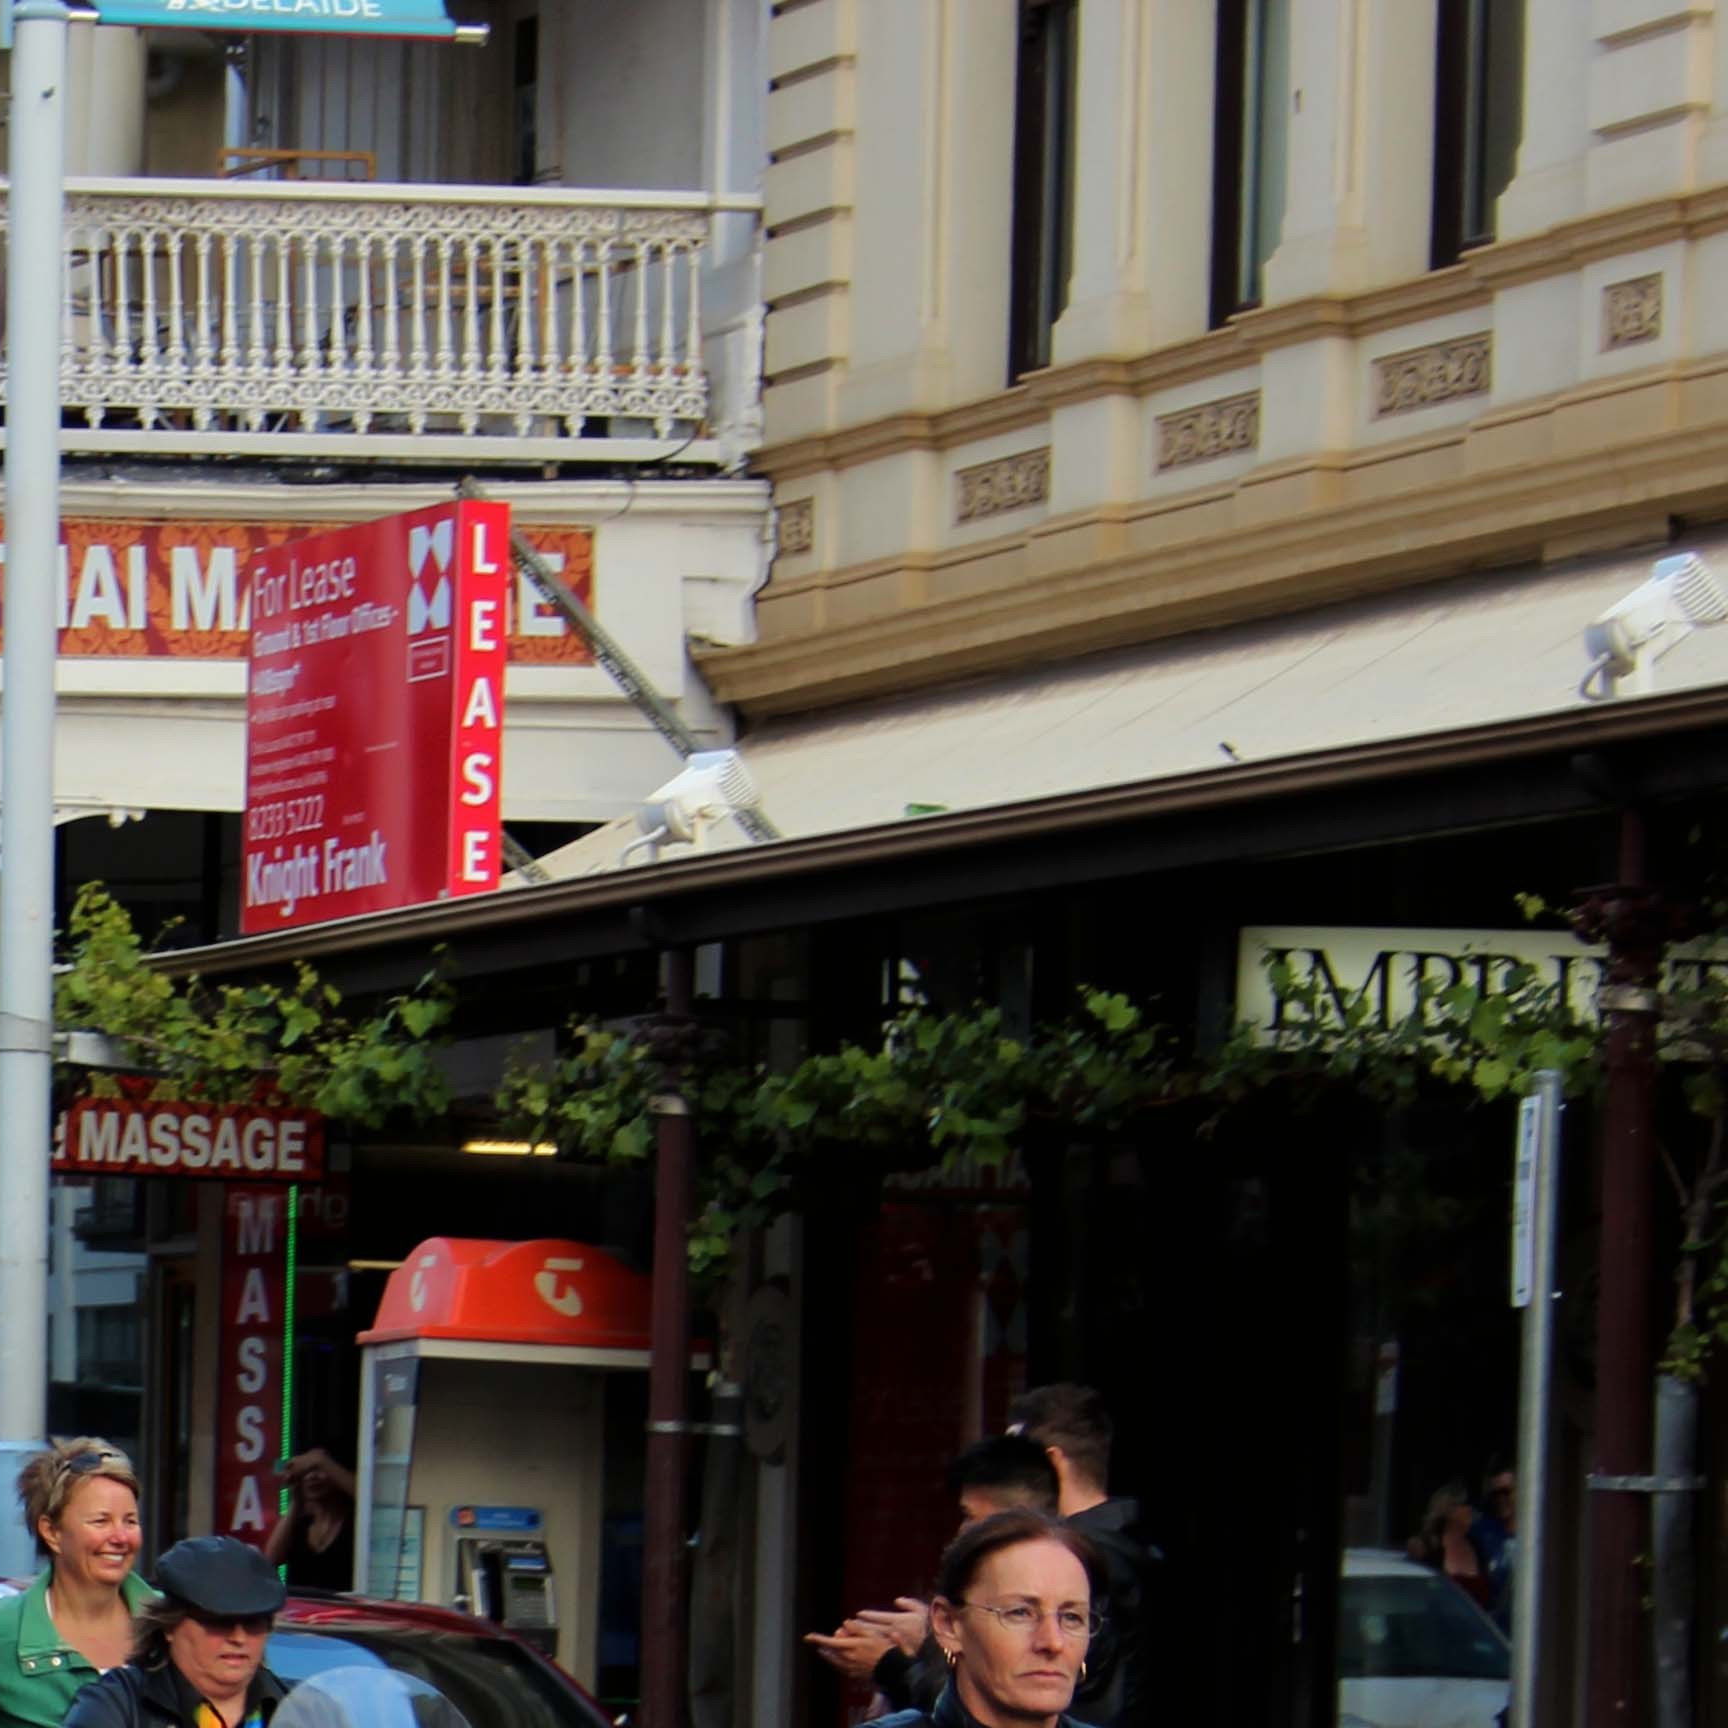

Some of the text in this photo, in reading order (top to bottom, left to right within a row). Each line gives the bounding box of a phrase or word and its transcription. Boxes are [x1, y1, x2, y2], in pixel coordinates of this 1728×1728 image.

[253, 564, 286, 619] For
[290, 556, 356, 611] Lease
[461, 522, 499, 883] LEASE
[245, 829, 389, 918] Knight Frank
[79, 1109, 307, 1172] MASSAGE
[230, 1200, 278, 1533] MASSA
